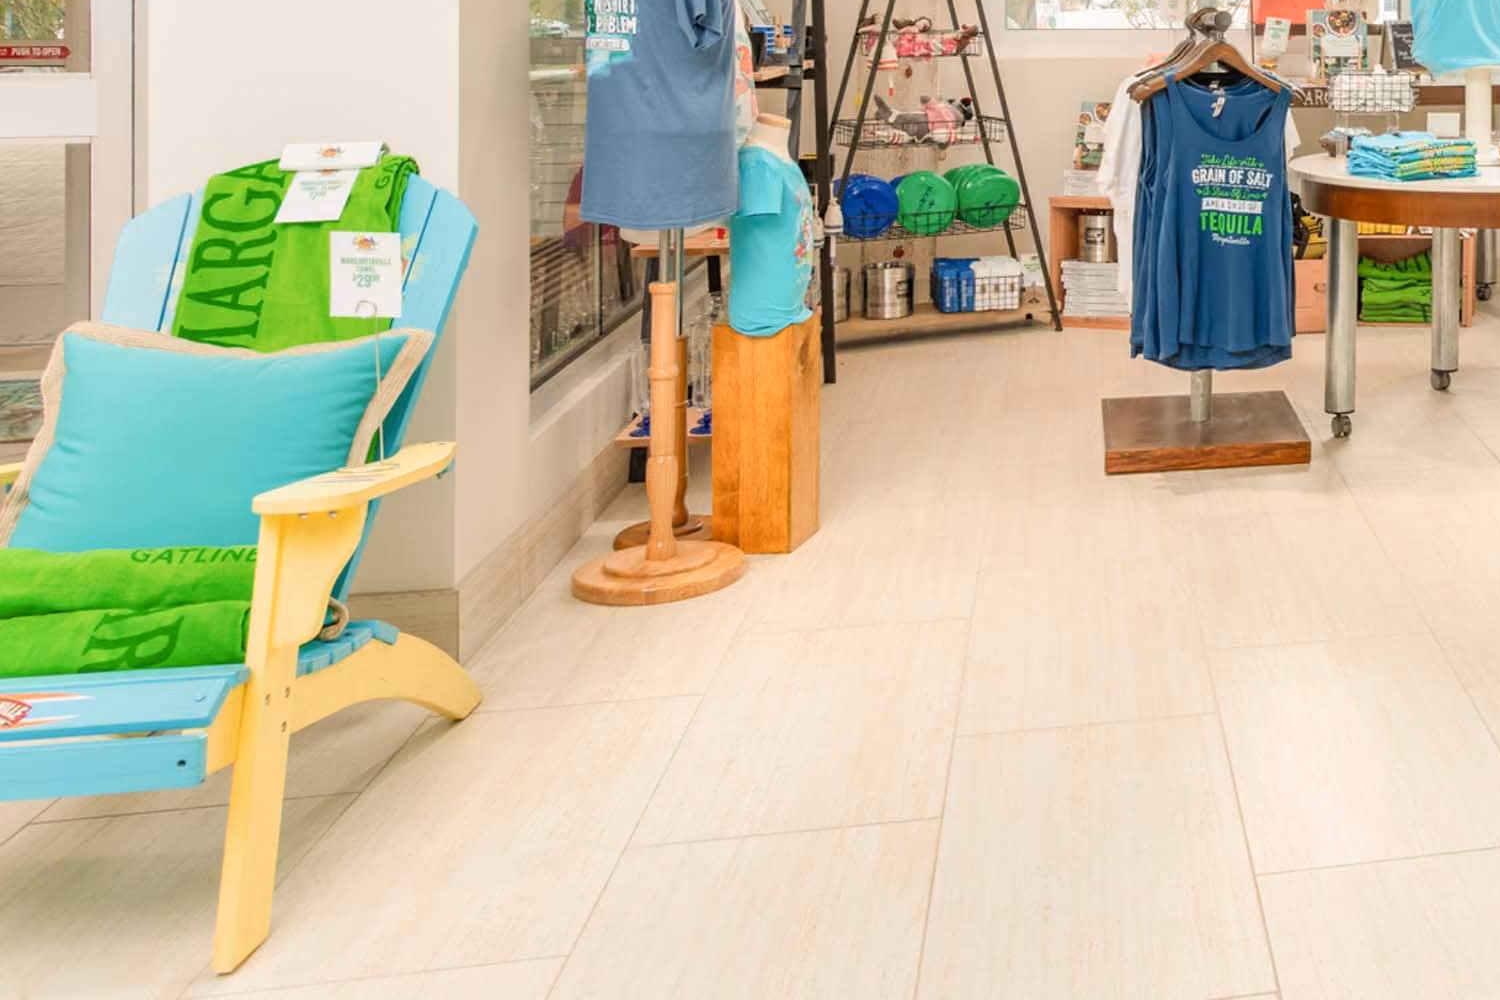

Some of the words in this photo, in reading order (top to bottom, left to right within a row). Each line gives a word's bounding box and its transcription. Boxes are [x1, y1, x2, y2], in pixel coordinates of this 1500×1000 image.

[1192, 168, 1226, 185] GRAIN
[1228, 169, 1245, 185] OF
[1246, 170, 1275, 189] SALT
[1200, 211, 1263, 236] TEQUILA
